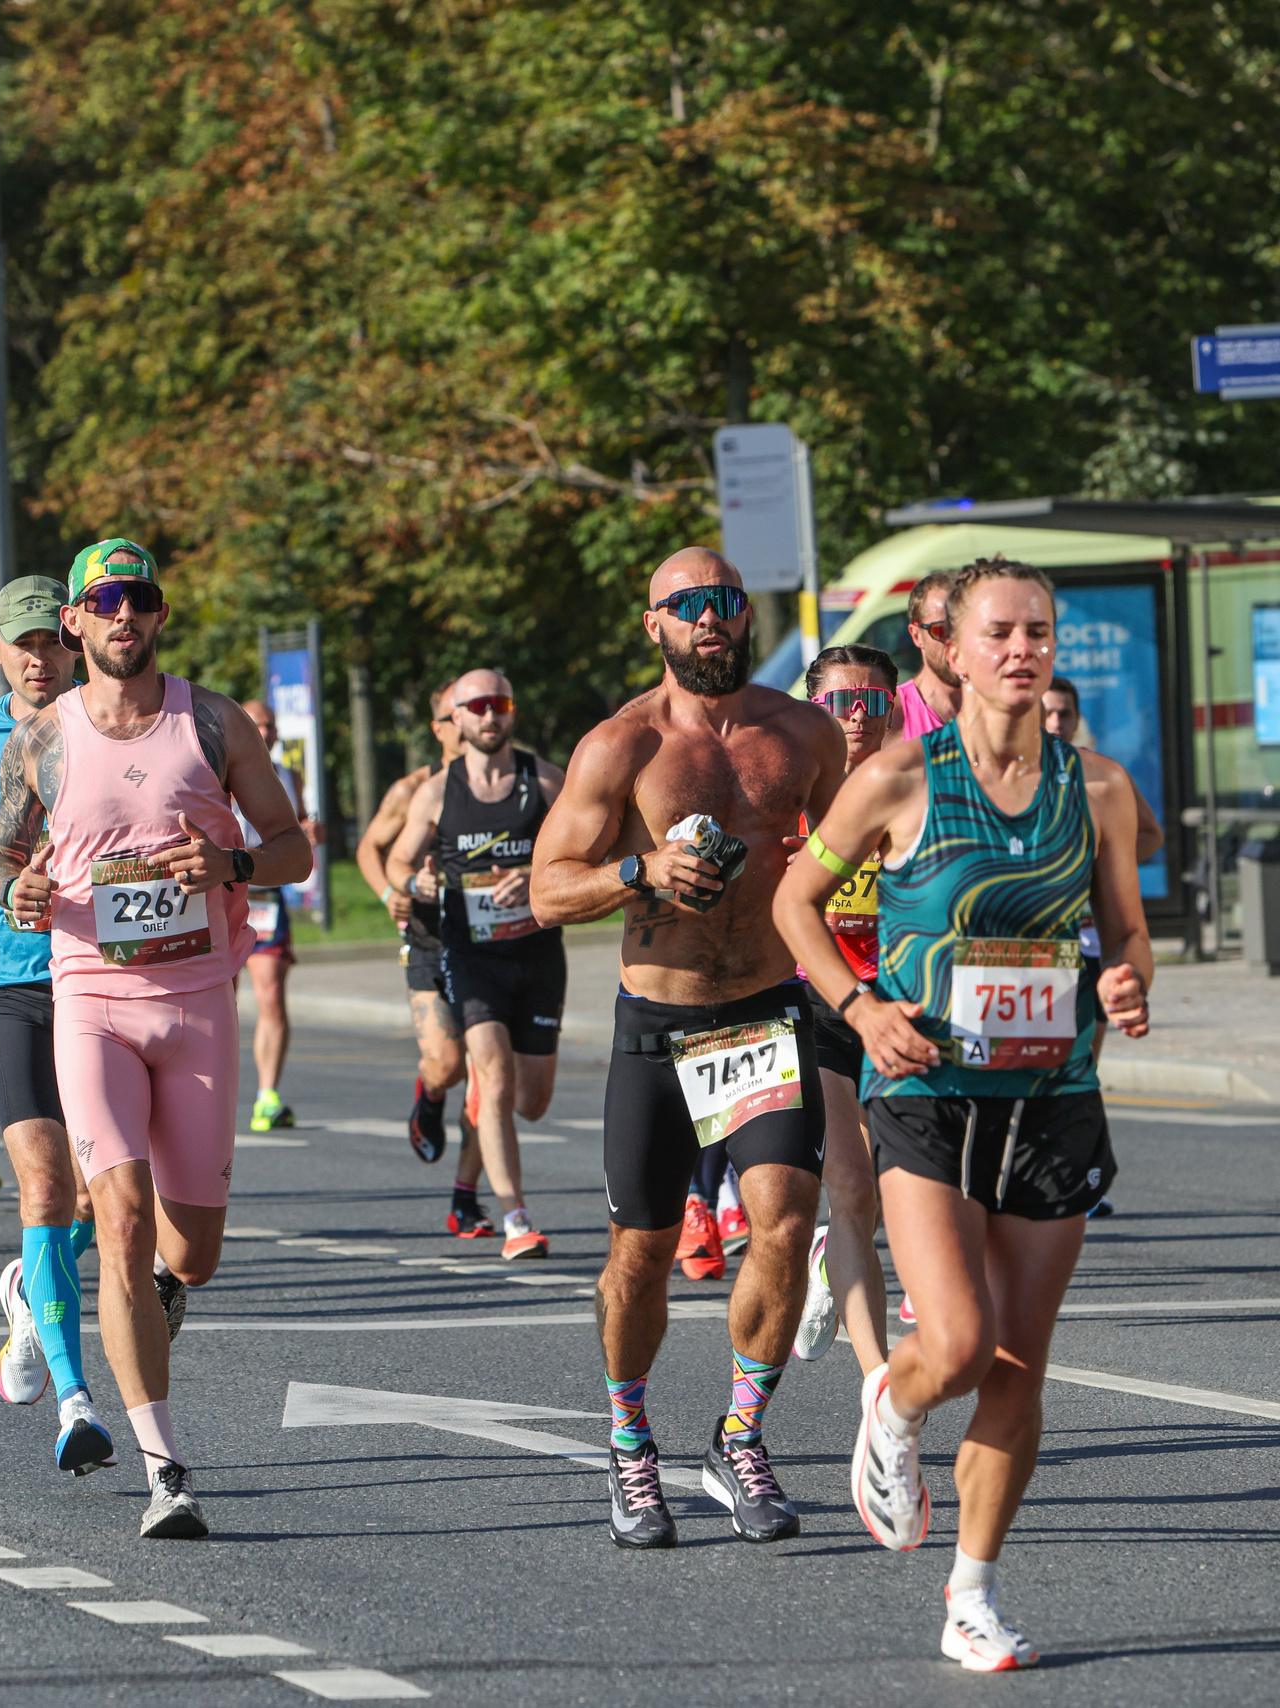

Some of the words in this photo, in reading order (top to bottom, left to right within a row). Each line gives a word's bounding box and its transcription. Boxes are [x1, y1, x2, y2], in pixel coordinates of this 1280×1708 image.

[1056, 621, 1130, 646] ОСТЬ
[1054, 650, 1120, 672] СИИ!
[458, 831, 493, 851] RUN
[491, 839, 532, 857] CLUB
[839, 869, 878, 898] 57
[111, 887, 190, 924] 2267
[828, 899, 852, 908] ЛЬГА
[142, 921, 169, 934] ОЛЕГ
[975, 985, 1054, 1022] 7511
[968, 1041, 985, 1060] A
[696, 1042, 777, 1096] 7417
[781, 1069, 795, 1080] VIP
[725, 1078, 762, 1101] МАКСИМ
[43, 1315, 63, 1325] cep
